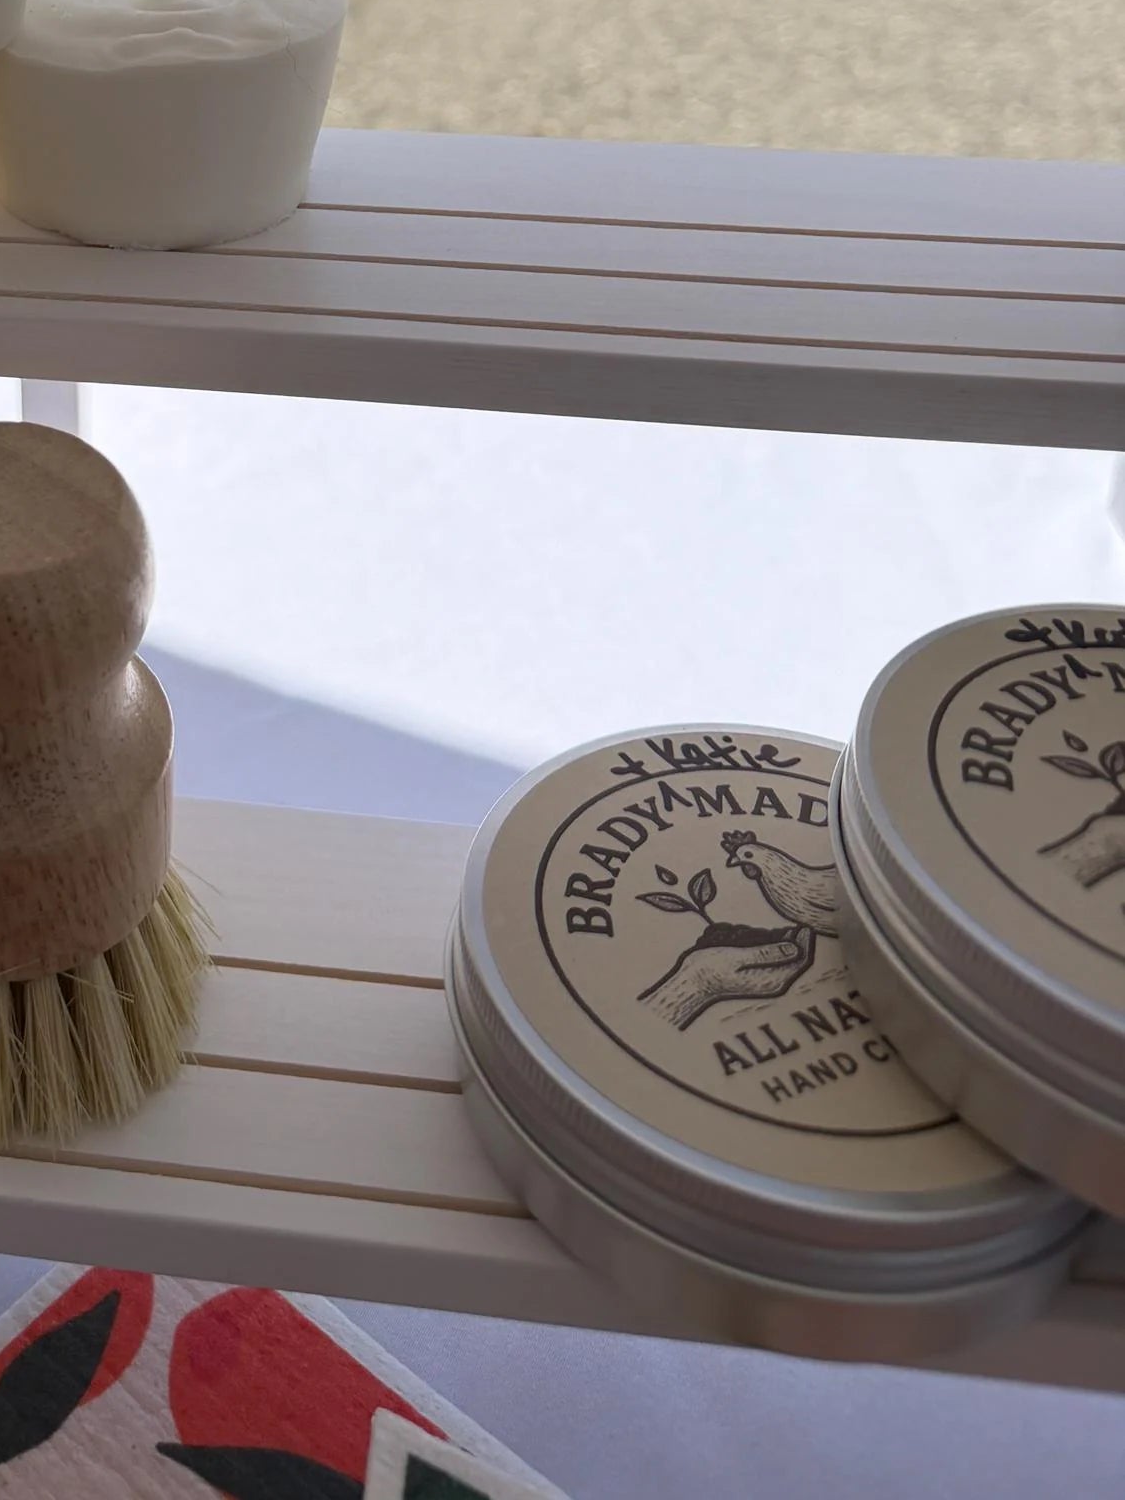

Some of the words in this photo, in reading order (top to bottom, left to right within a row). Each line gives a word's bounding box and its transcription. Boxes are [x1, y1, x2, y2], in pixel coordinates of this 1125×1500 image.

[644, 734, 802, 770] Katie
[960, 665, 1087, 793] BRADY
[563, 795, 674, 938] BRADY
[711, 1022, 802, 1077] ALL
[760, 1051, 859, 1103] HAND
